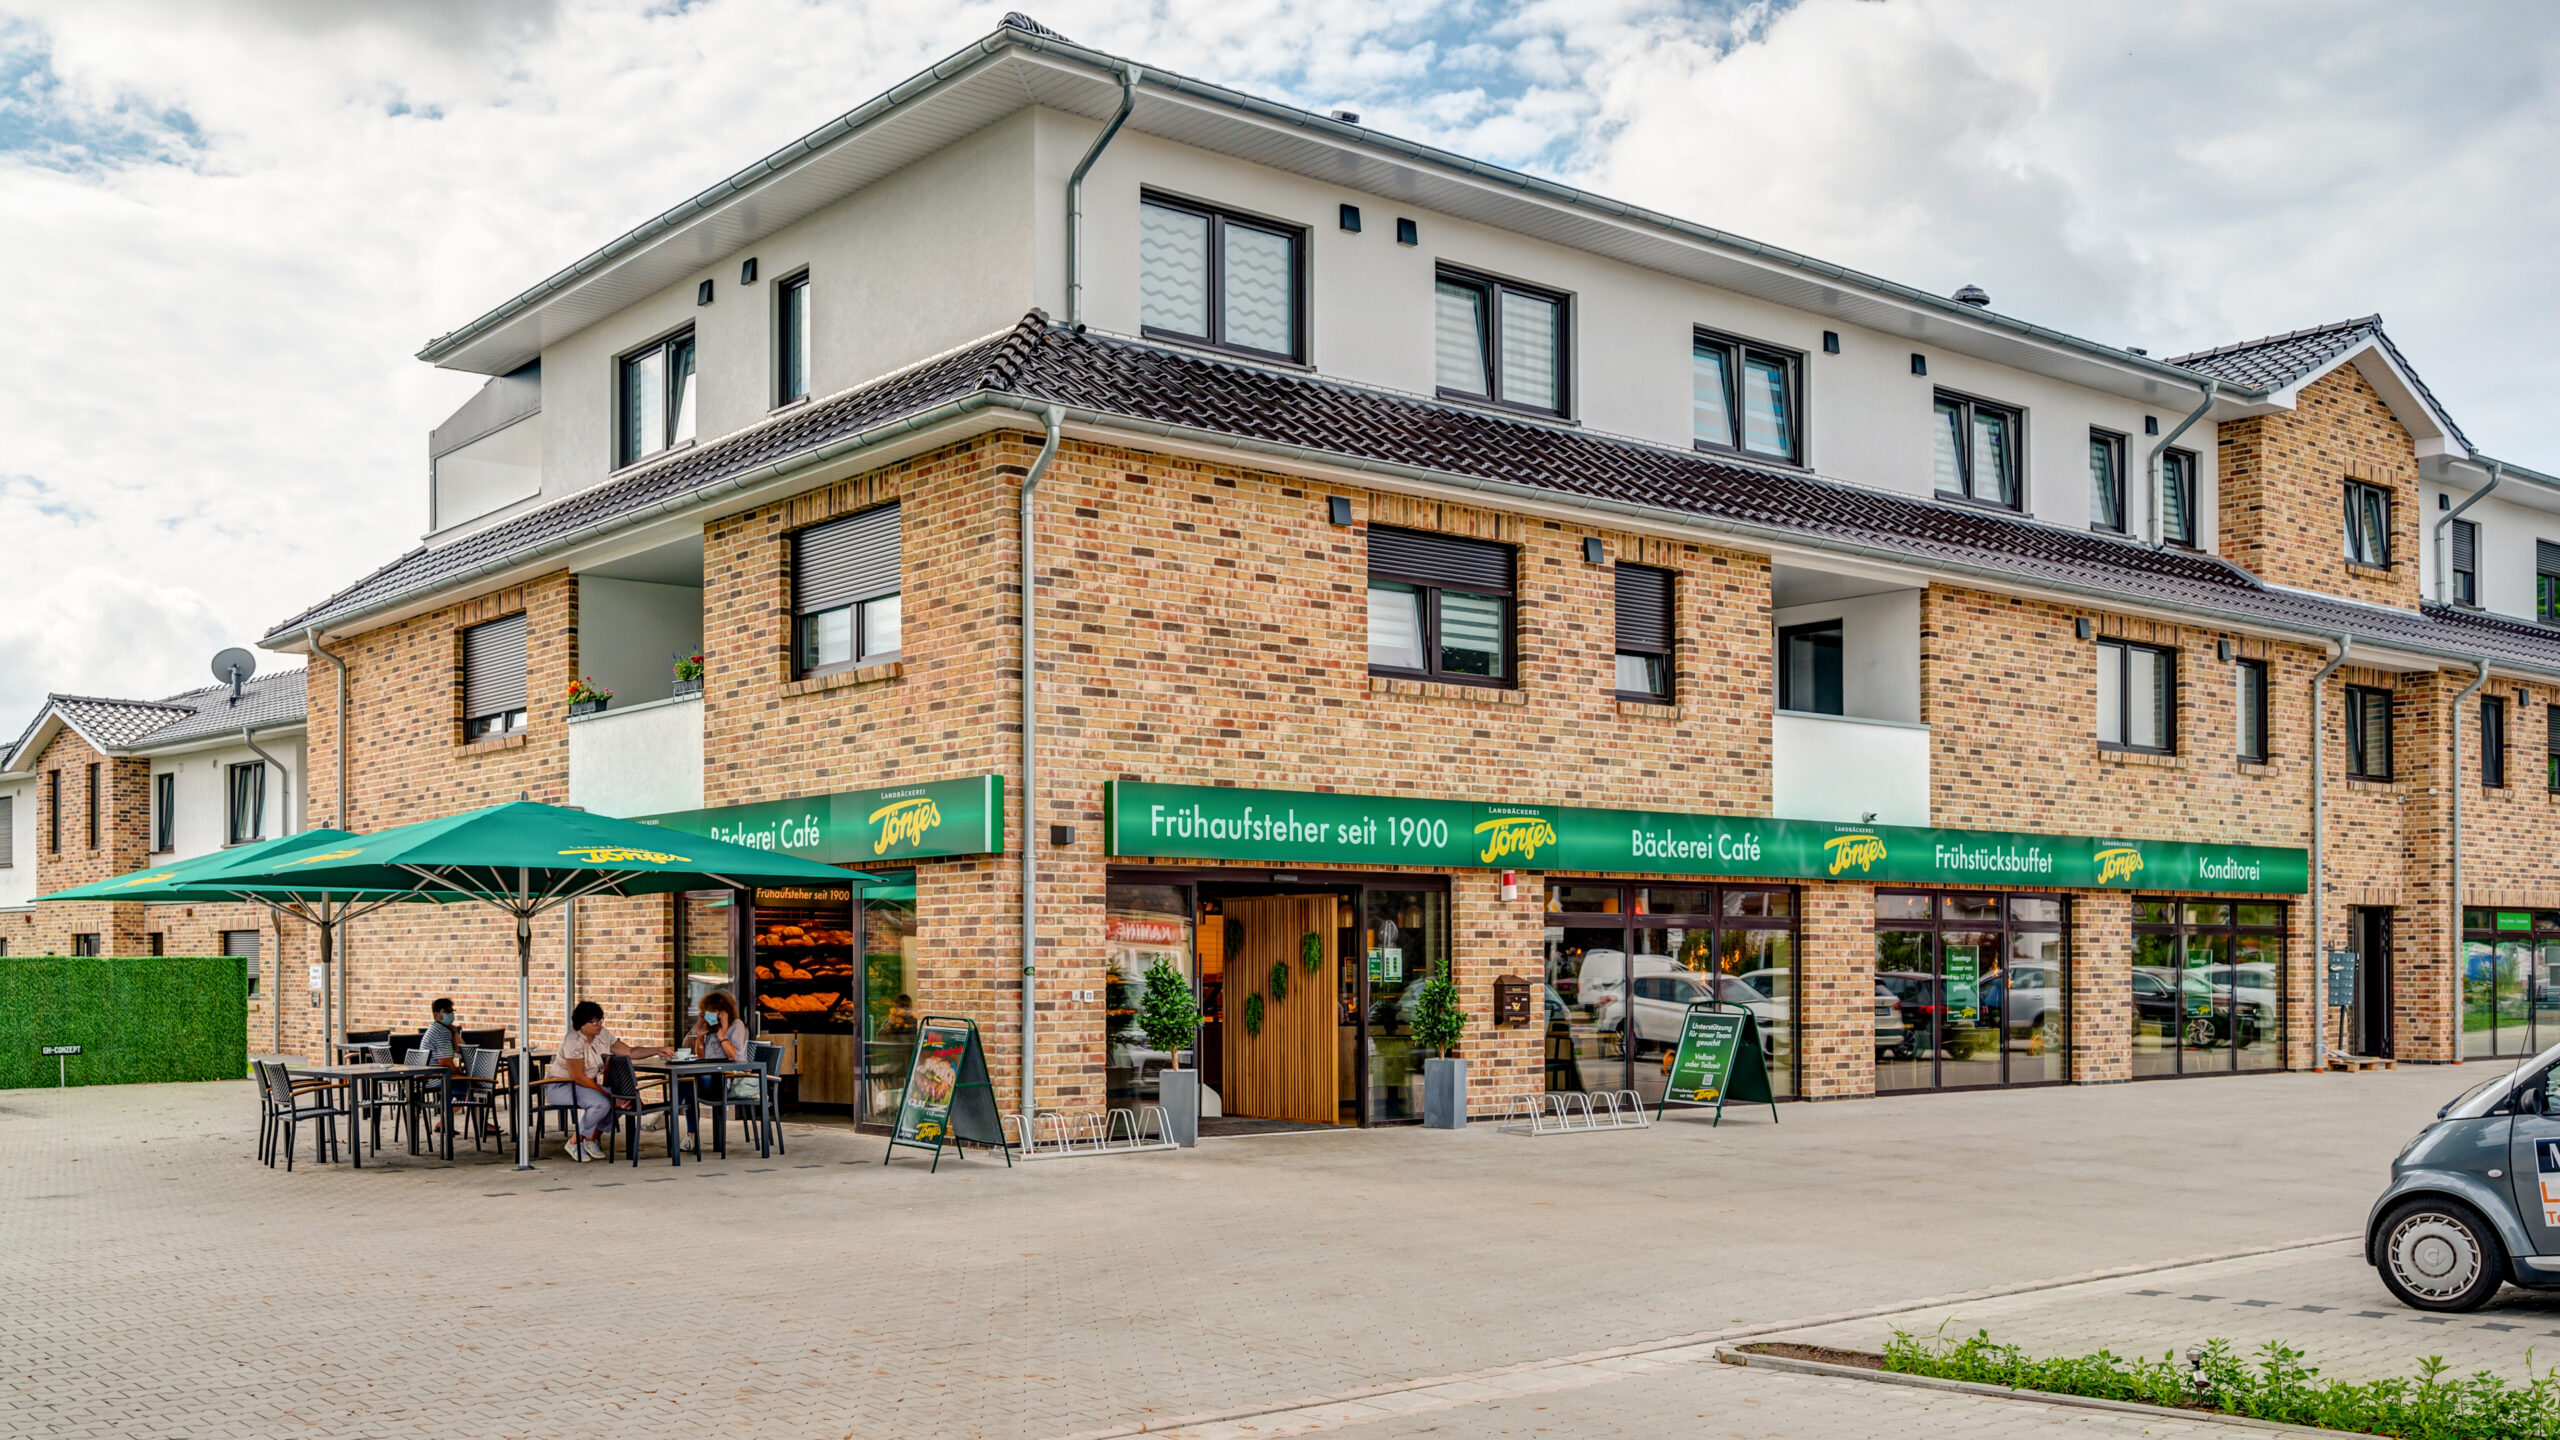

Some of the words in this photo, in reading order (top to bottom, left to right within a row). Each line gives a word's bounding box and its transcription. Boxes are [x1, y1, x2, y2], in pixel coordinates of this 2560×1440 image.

[1151, 804, 1330, 843] Frühaufsteher
[1337, 815, 1377, 845] seit
[1387, 816, 1448, 848] 1900
[1488, 806, 1540, 815] LANDBÄCKEREI
[780, 814, 820, 848] Café
[869, 798, 941, 855] Tönjes
[1474, 817, 1557, 863] Tönjes
[1631, 829, 1713, 859] Bäckerei
[1717, 832, 1761, 862] Café
[1823, 834, 1887, 876] Tönjes
[1935, 843, 2053, 873] Frühstücksbuffet
[2093, 848, 2144, 884] Tönjes
[2199, 856, 2260, 880] Konditorei
[756, 887, 812, 900] Frühaufsteher
[814, 889, 828, 900] seit
[830, 890, 850, 900] 1900
[1691, 1022, 1733, 1032] Unterstützung
[1685, 1060, 1700, 1068] oder
[1701, 1061, 1721, 1069] Teilzeit
[1694, 1053, 1716, 1061] Vollzeit
